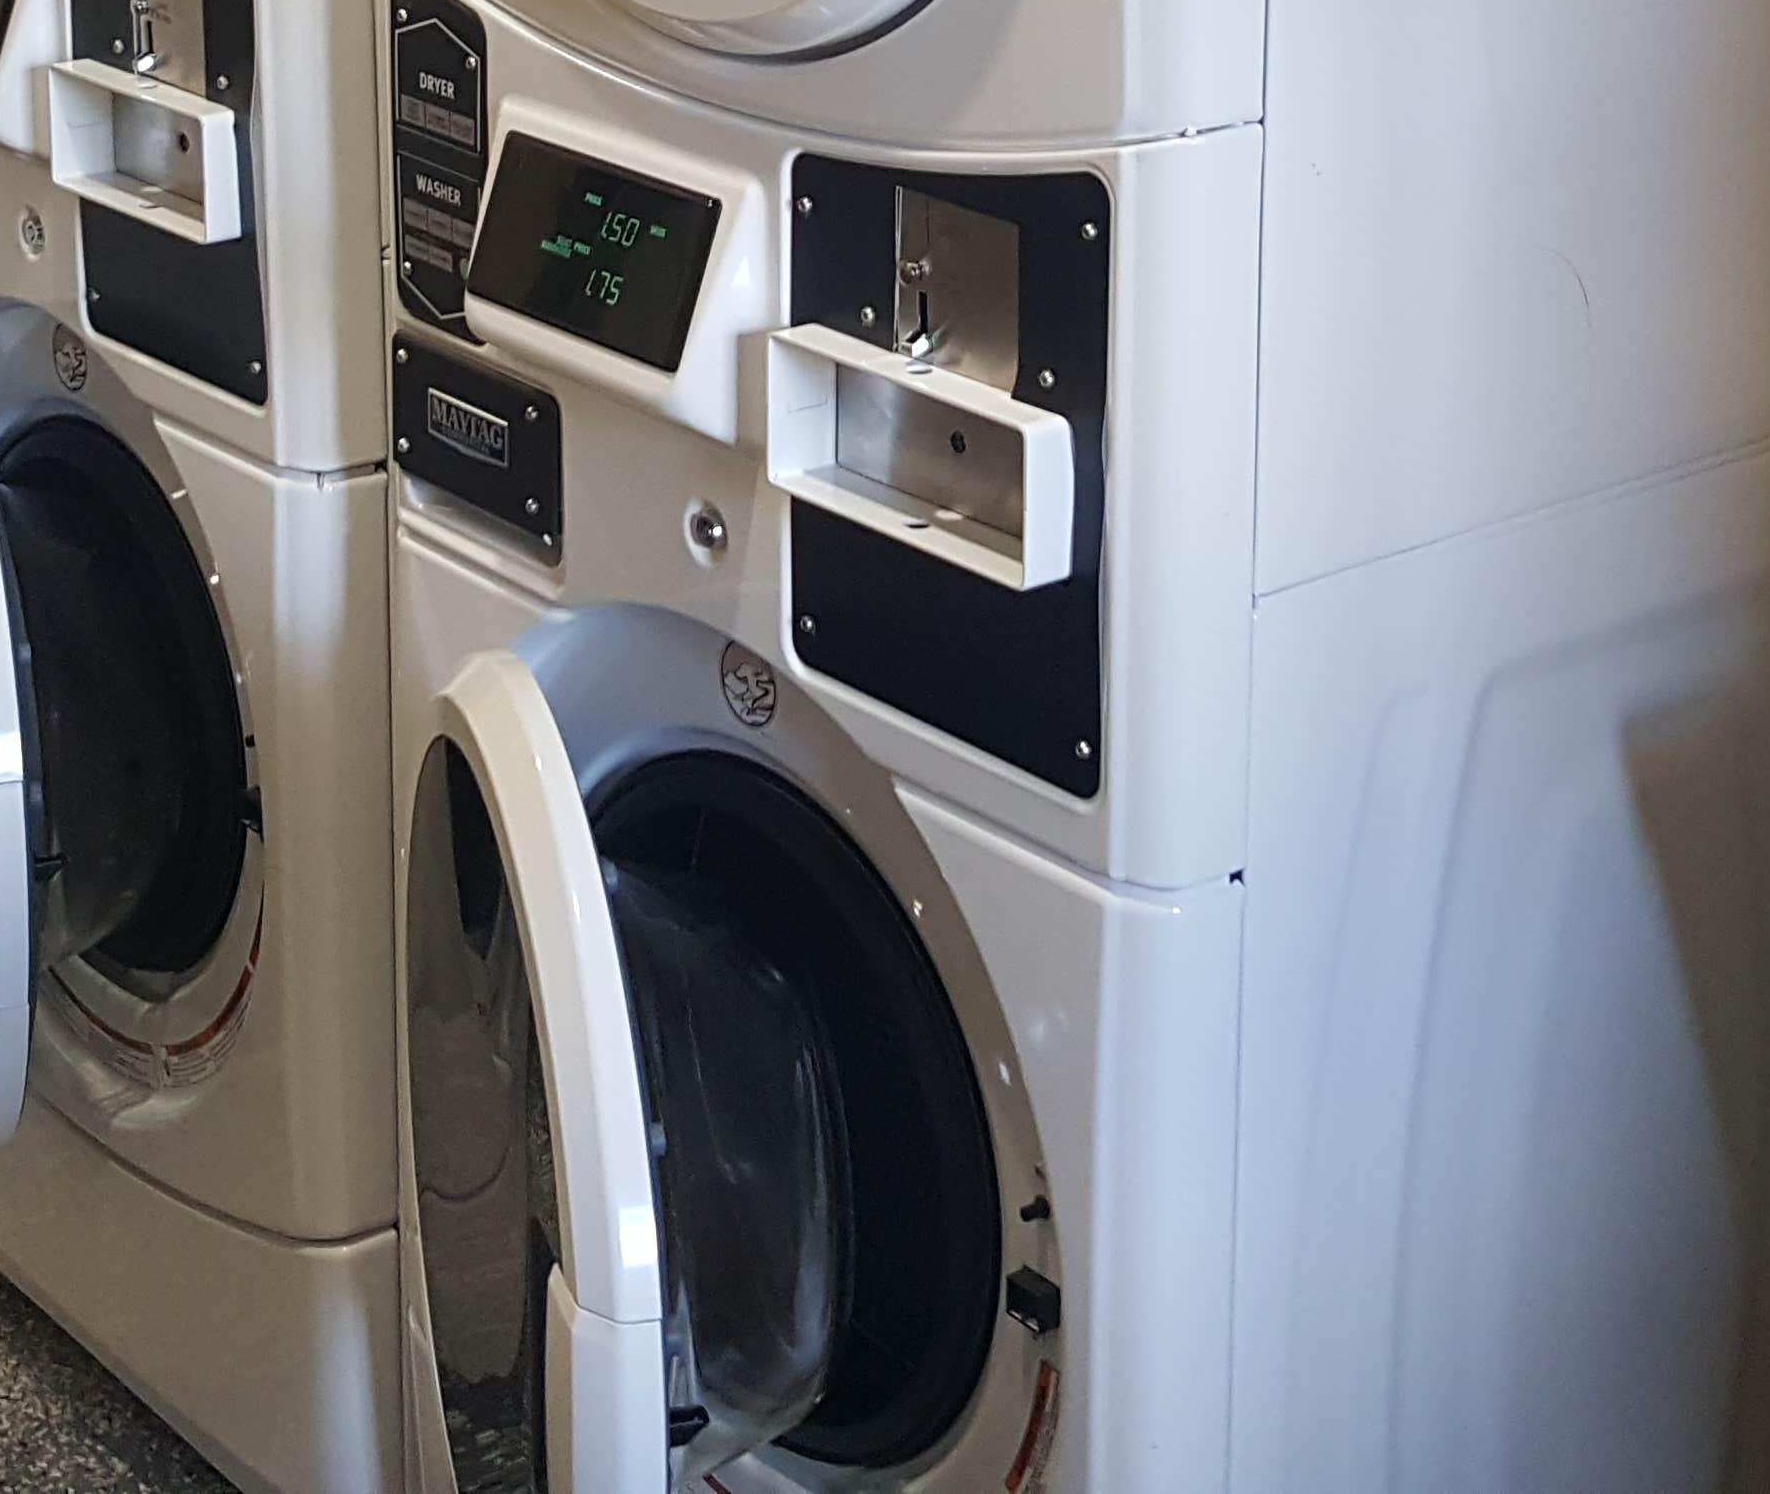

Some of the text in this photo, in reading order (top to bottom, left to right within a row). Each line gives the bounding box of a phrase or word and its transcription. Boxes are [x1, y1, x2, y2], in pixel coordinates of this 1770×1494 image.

[419, 71, 455, 99] DRYER
[415, 174, 461, 206] WASHER
[431, 396, 503, 450] MAYTAG
